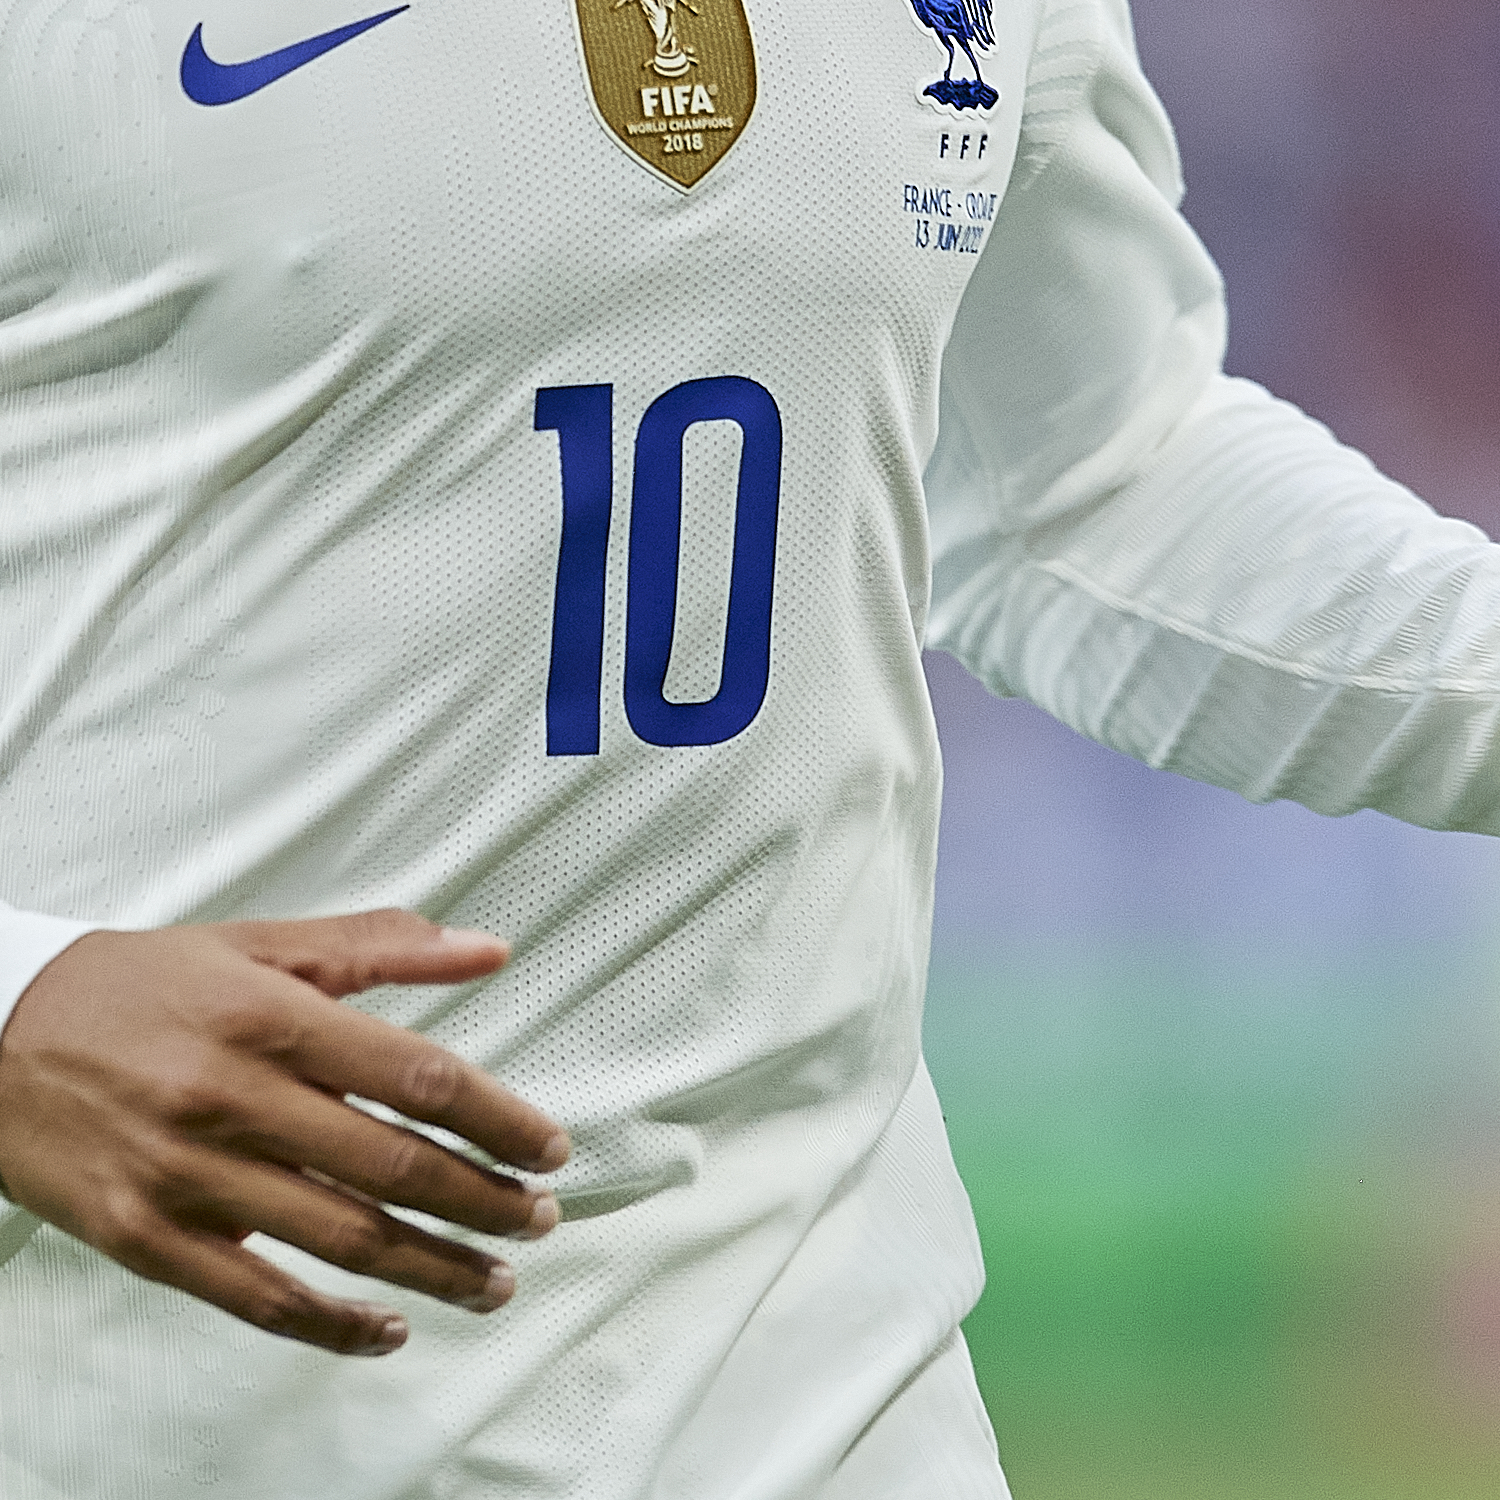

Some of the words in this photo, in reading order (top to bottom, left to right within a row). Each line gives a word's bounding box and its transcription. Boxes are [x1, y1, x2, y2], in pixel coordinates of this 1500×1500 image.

[641, 84, 715, 117] FIFA
[626, 120, 667, 135] WORLD
[668, 117, 734, 132] CHAMPIONS
[662, 132, 703, 153] 2018
[903, 184, 952, 217] FRANCE
[915, 219, 929, 248] 13
[533, 375, 783, 757] 10
